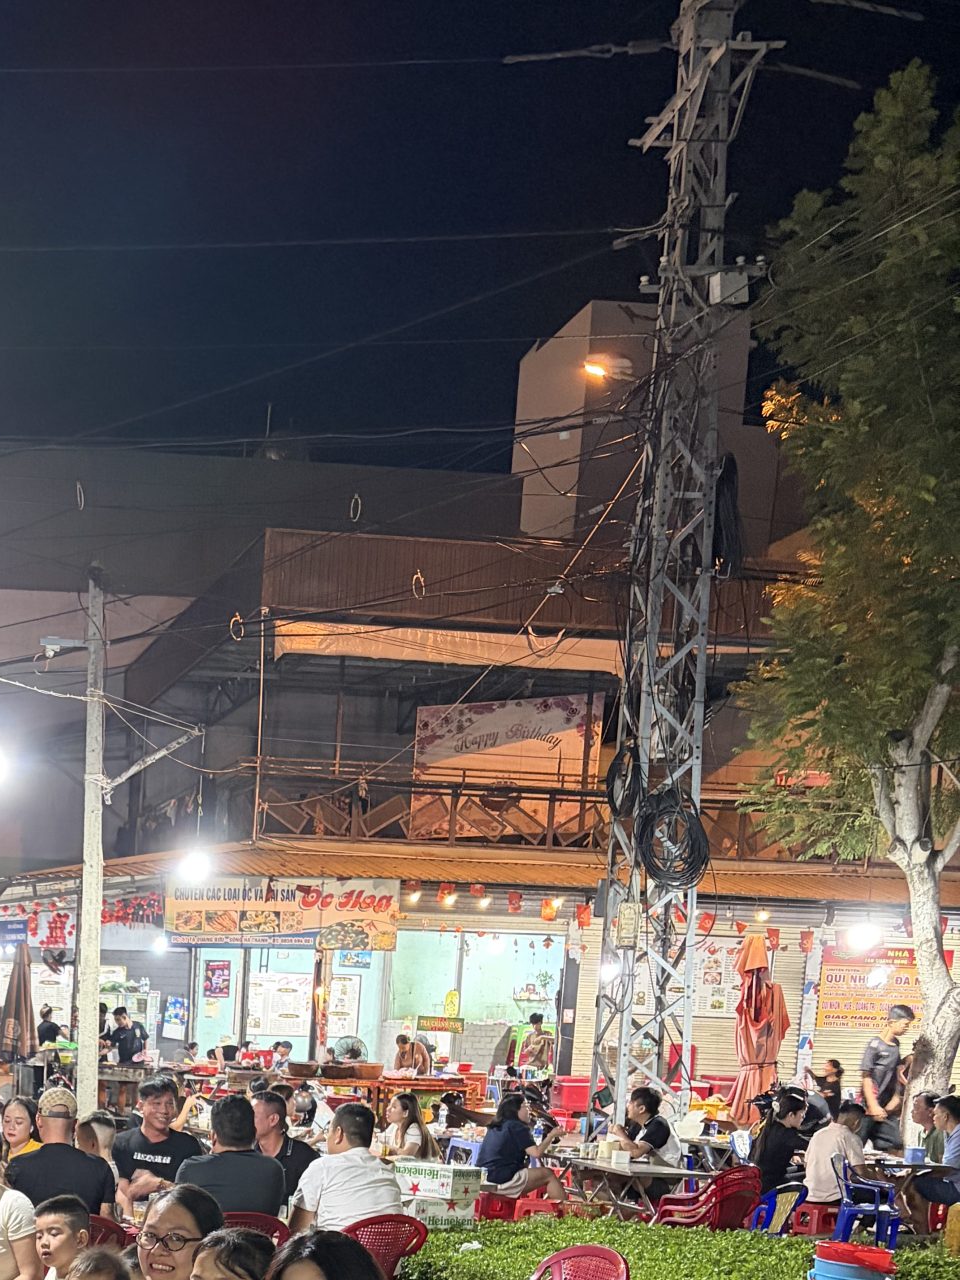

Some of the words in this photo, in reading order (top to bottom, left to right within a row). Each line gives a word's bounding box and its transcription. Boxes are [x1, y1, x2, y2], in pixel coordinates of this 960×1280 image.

[454, 729, 500, 753] Happy
[505, 723, 562, 751] Birthday
[826, 974, 846, 983] QUI
[395, 1165, 440, 1180] Heineken
[427, 1215, 473, 1227] Heineken
